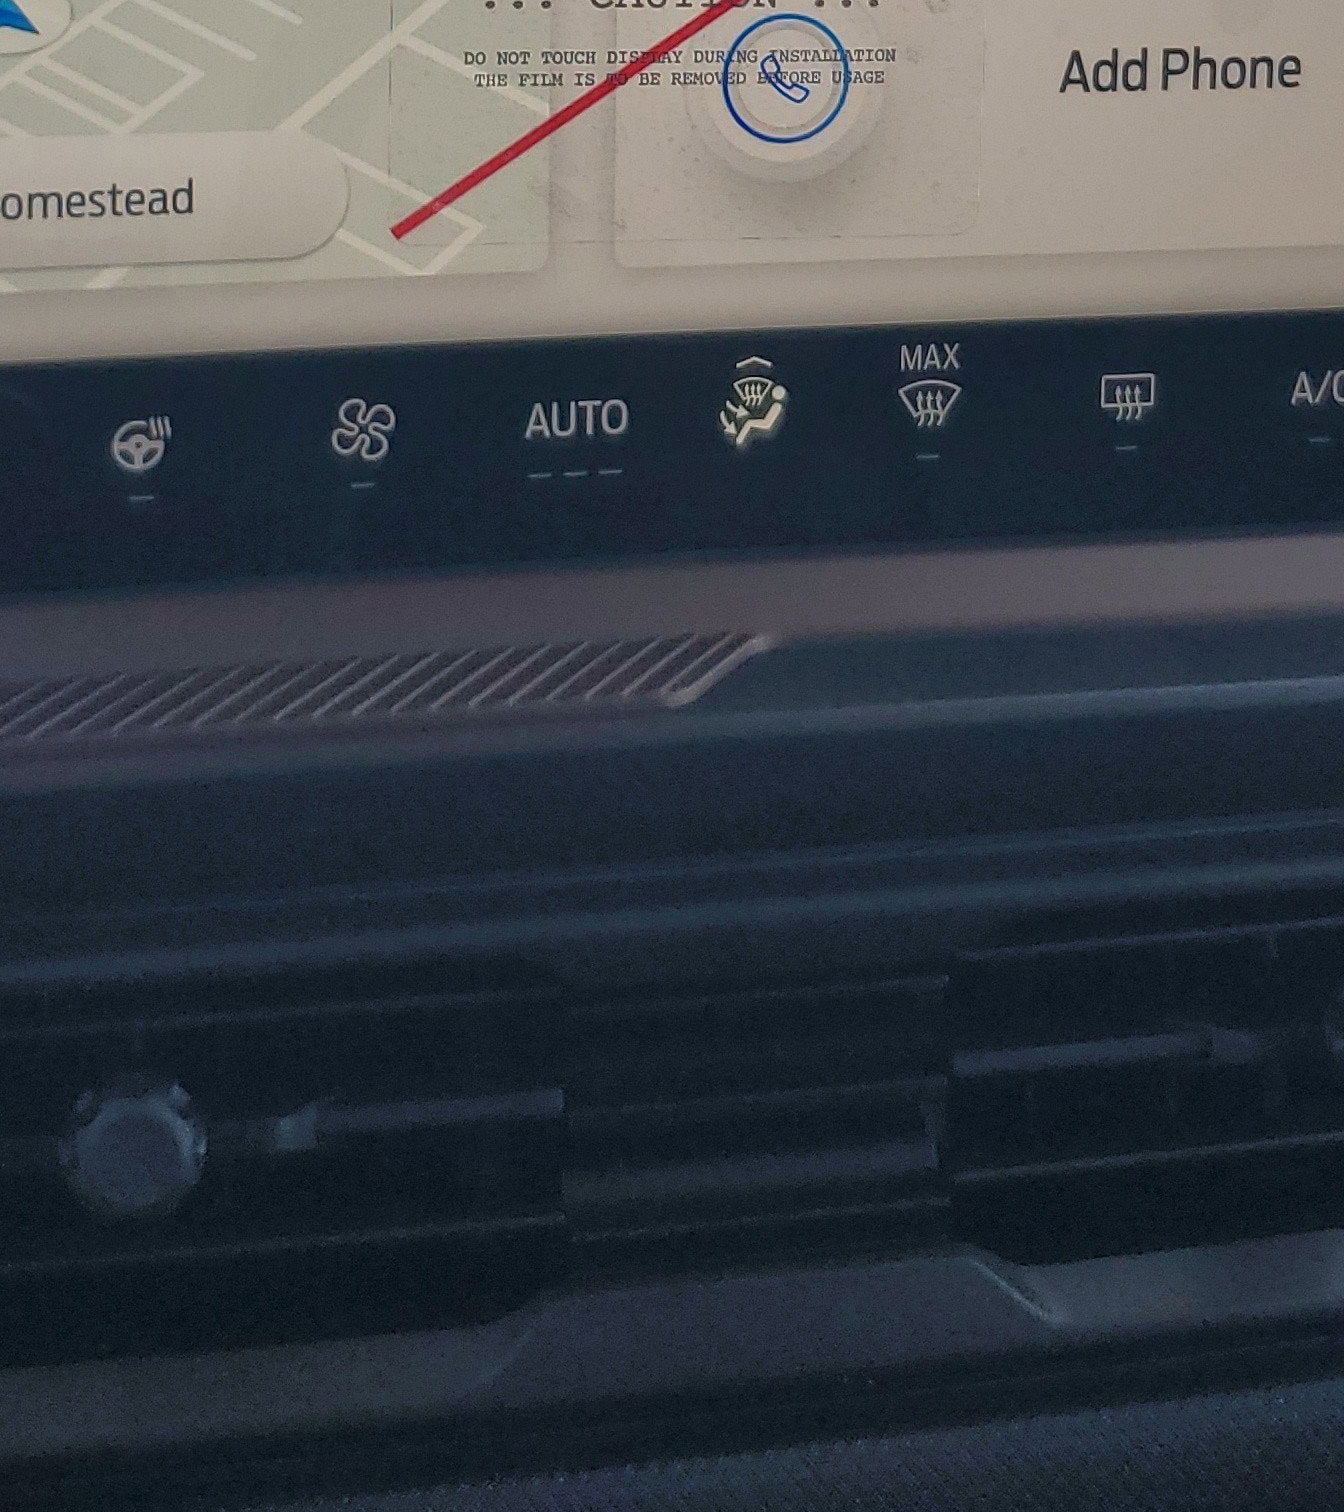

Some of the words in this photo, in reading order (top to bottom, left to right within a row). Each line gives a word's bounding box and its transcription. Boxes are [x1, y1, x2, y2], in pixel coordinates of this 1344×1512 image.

[464, 51, 486, 65] DO
[497, 51, 531, 65] NOT
[541, 50, 597, 65] TOUCH
[693, 49, 758, 64] DURING
[768, 48, 897, 63] INSTALLATION
[1059, 47, 1147, 93] Add
[1162, 46, 1301, 90] Phone
[474, 73, 508, 88] THE
[518, 73, 564, 88] FILM
[573, 73, 596, 87] IS
[638, 72, 662, 86] BE
[670, 71, 747, 86] REMOVED
[831, 70, 885, 85] USAGE
[899, 342, 961, 370] MAX
[525, 399, 628, 438] AUTO
